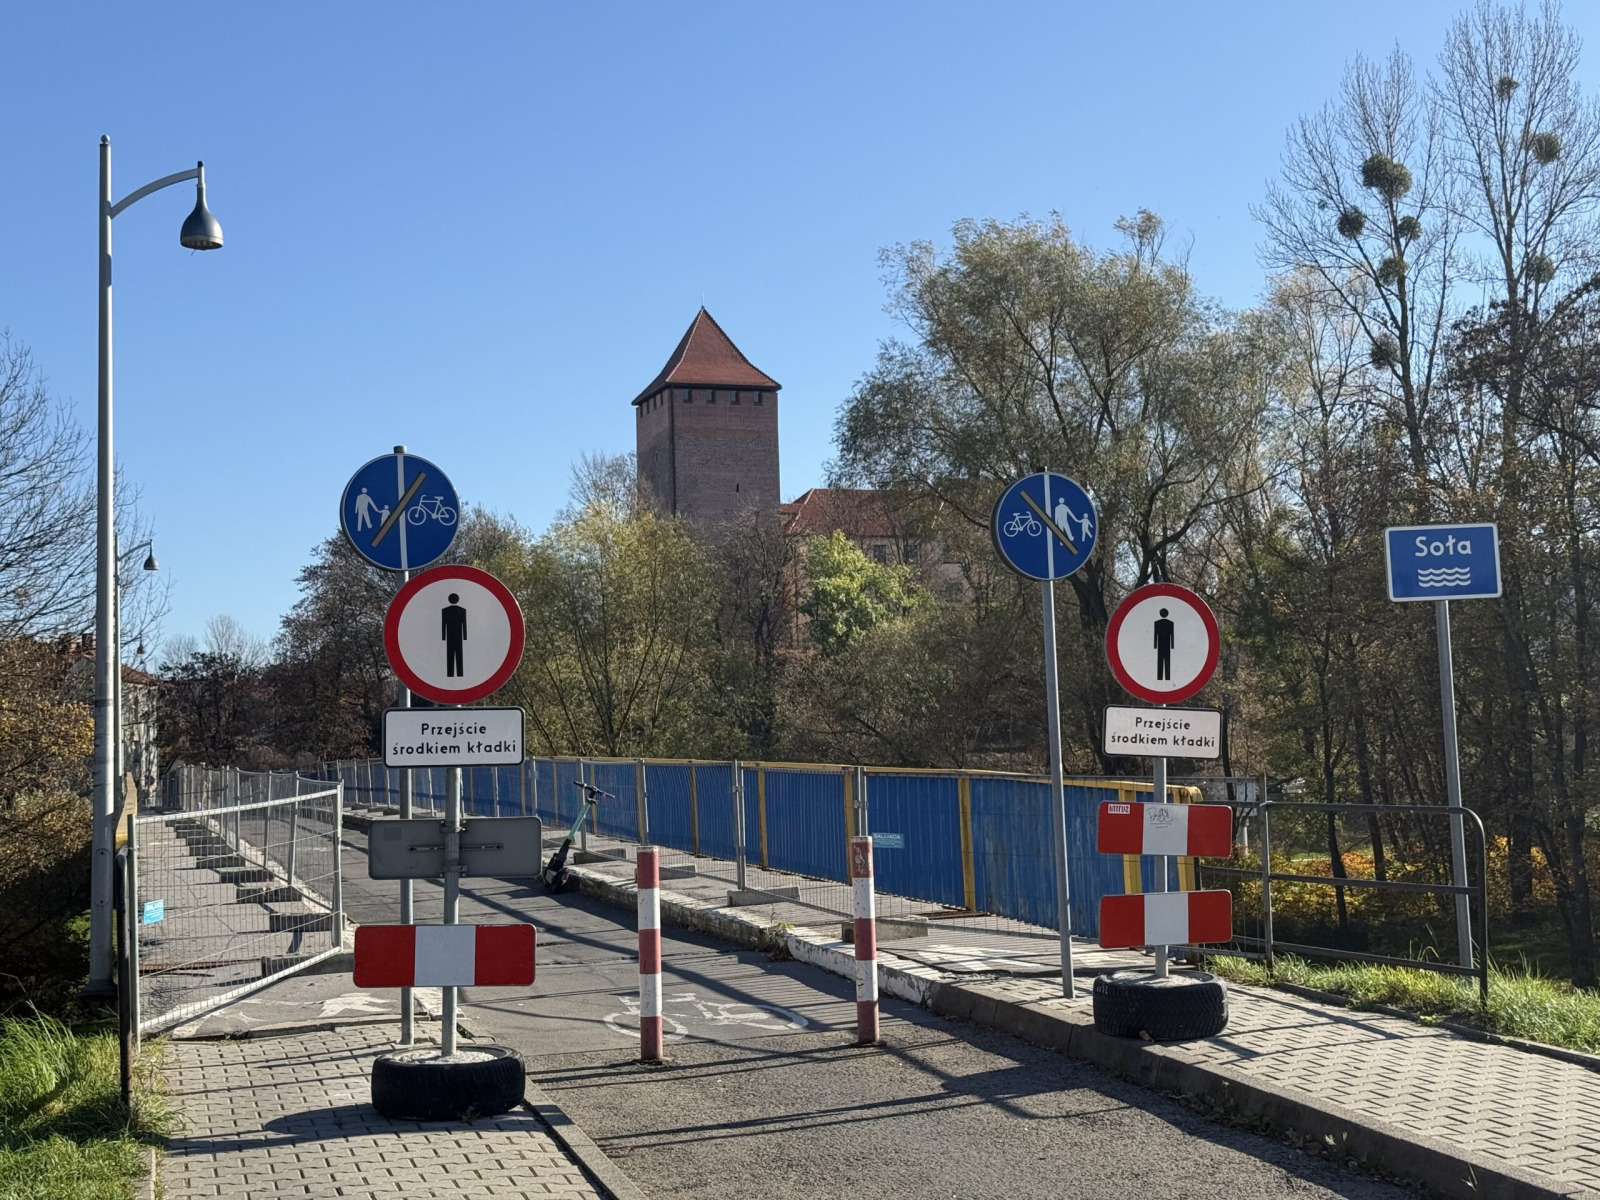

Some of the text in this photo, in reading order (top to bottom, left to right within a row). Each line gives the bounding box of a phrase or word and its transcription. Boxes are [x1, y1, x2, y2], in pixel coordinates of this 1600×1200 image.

[1415, 535, 1472, 557] Soła
[421, 722, 487, 738] Przejście
[1135, 717, 1191, 731] Przejście
[1111, 732, 1215, 747] środkiem kładki
[392, 740, 516, 755] środkiem kładki
